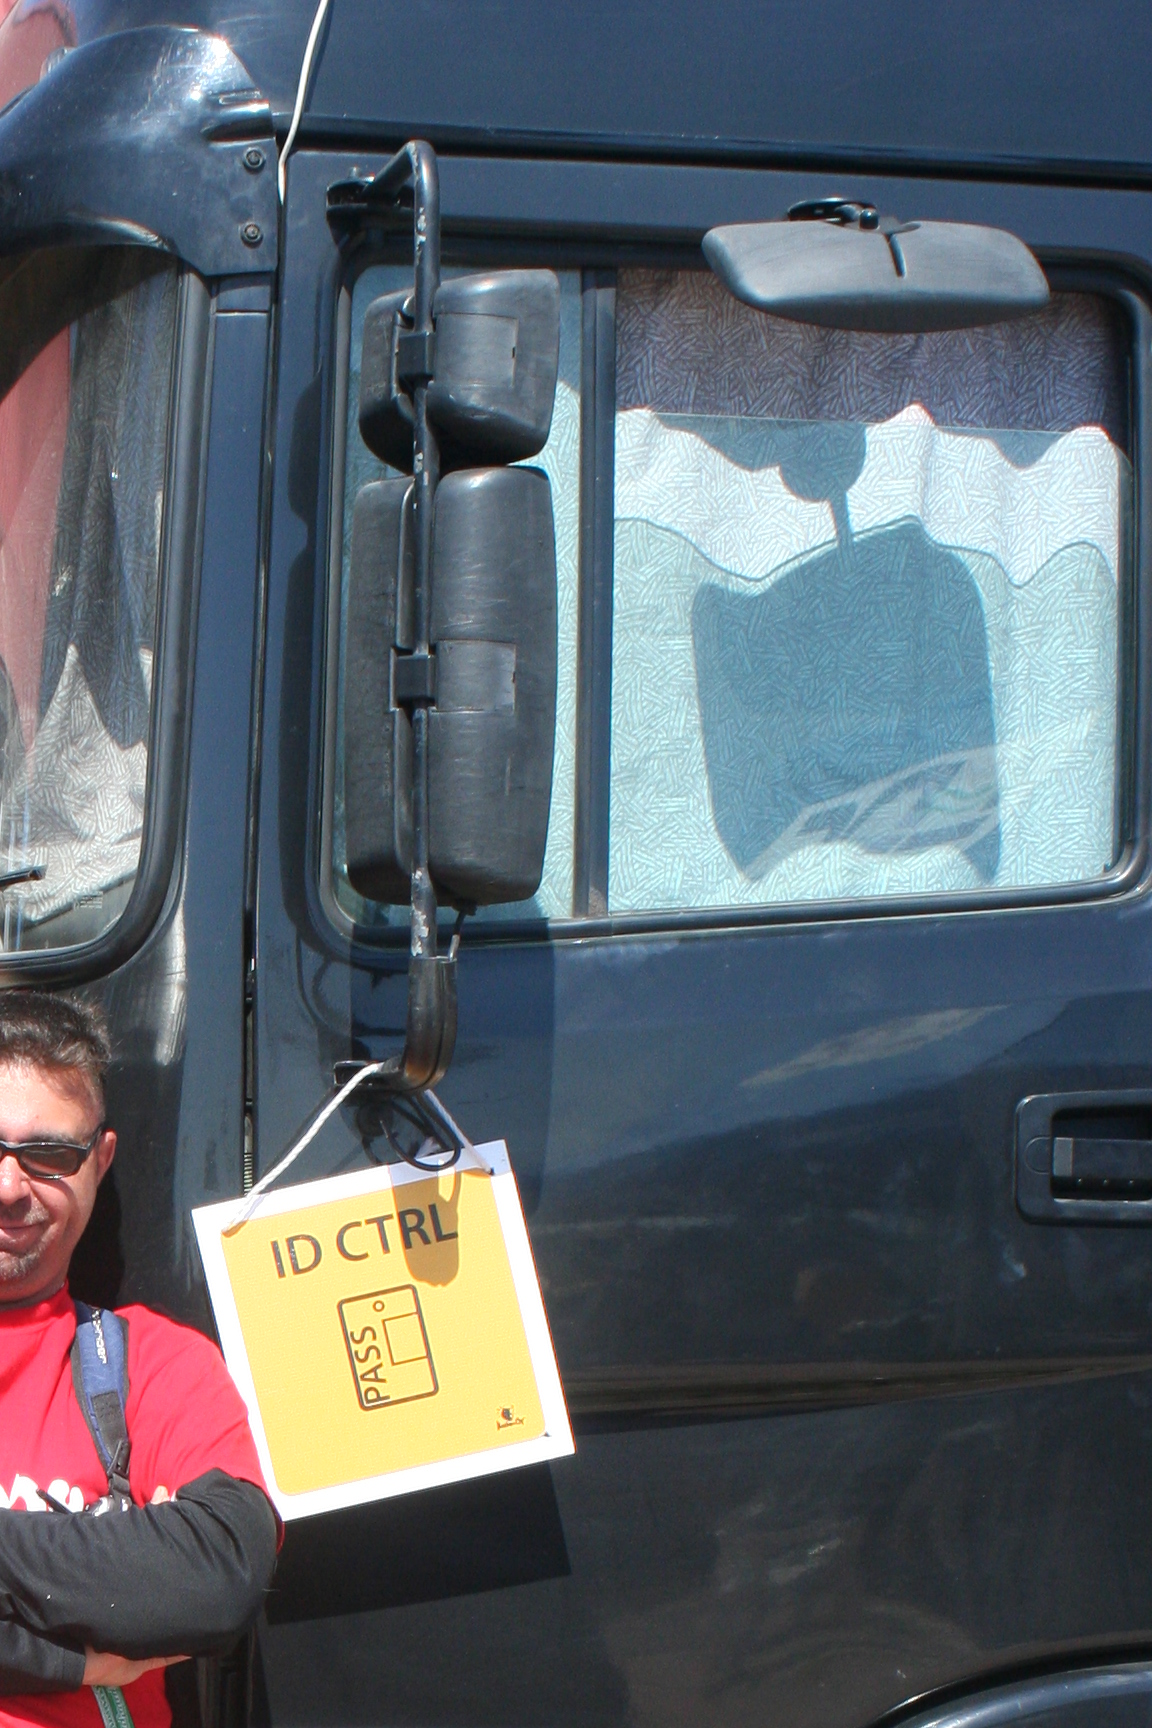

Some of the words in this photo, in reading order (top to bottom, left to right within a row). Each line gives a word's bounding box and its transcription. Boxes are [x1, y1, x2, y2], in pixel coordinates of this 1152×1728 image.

[270, 1233, 322, 1279] ID
[336, 1202, 458, 1261] CTRL
[349, 1325, 391, 1404] PASS
